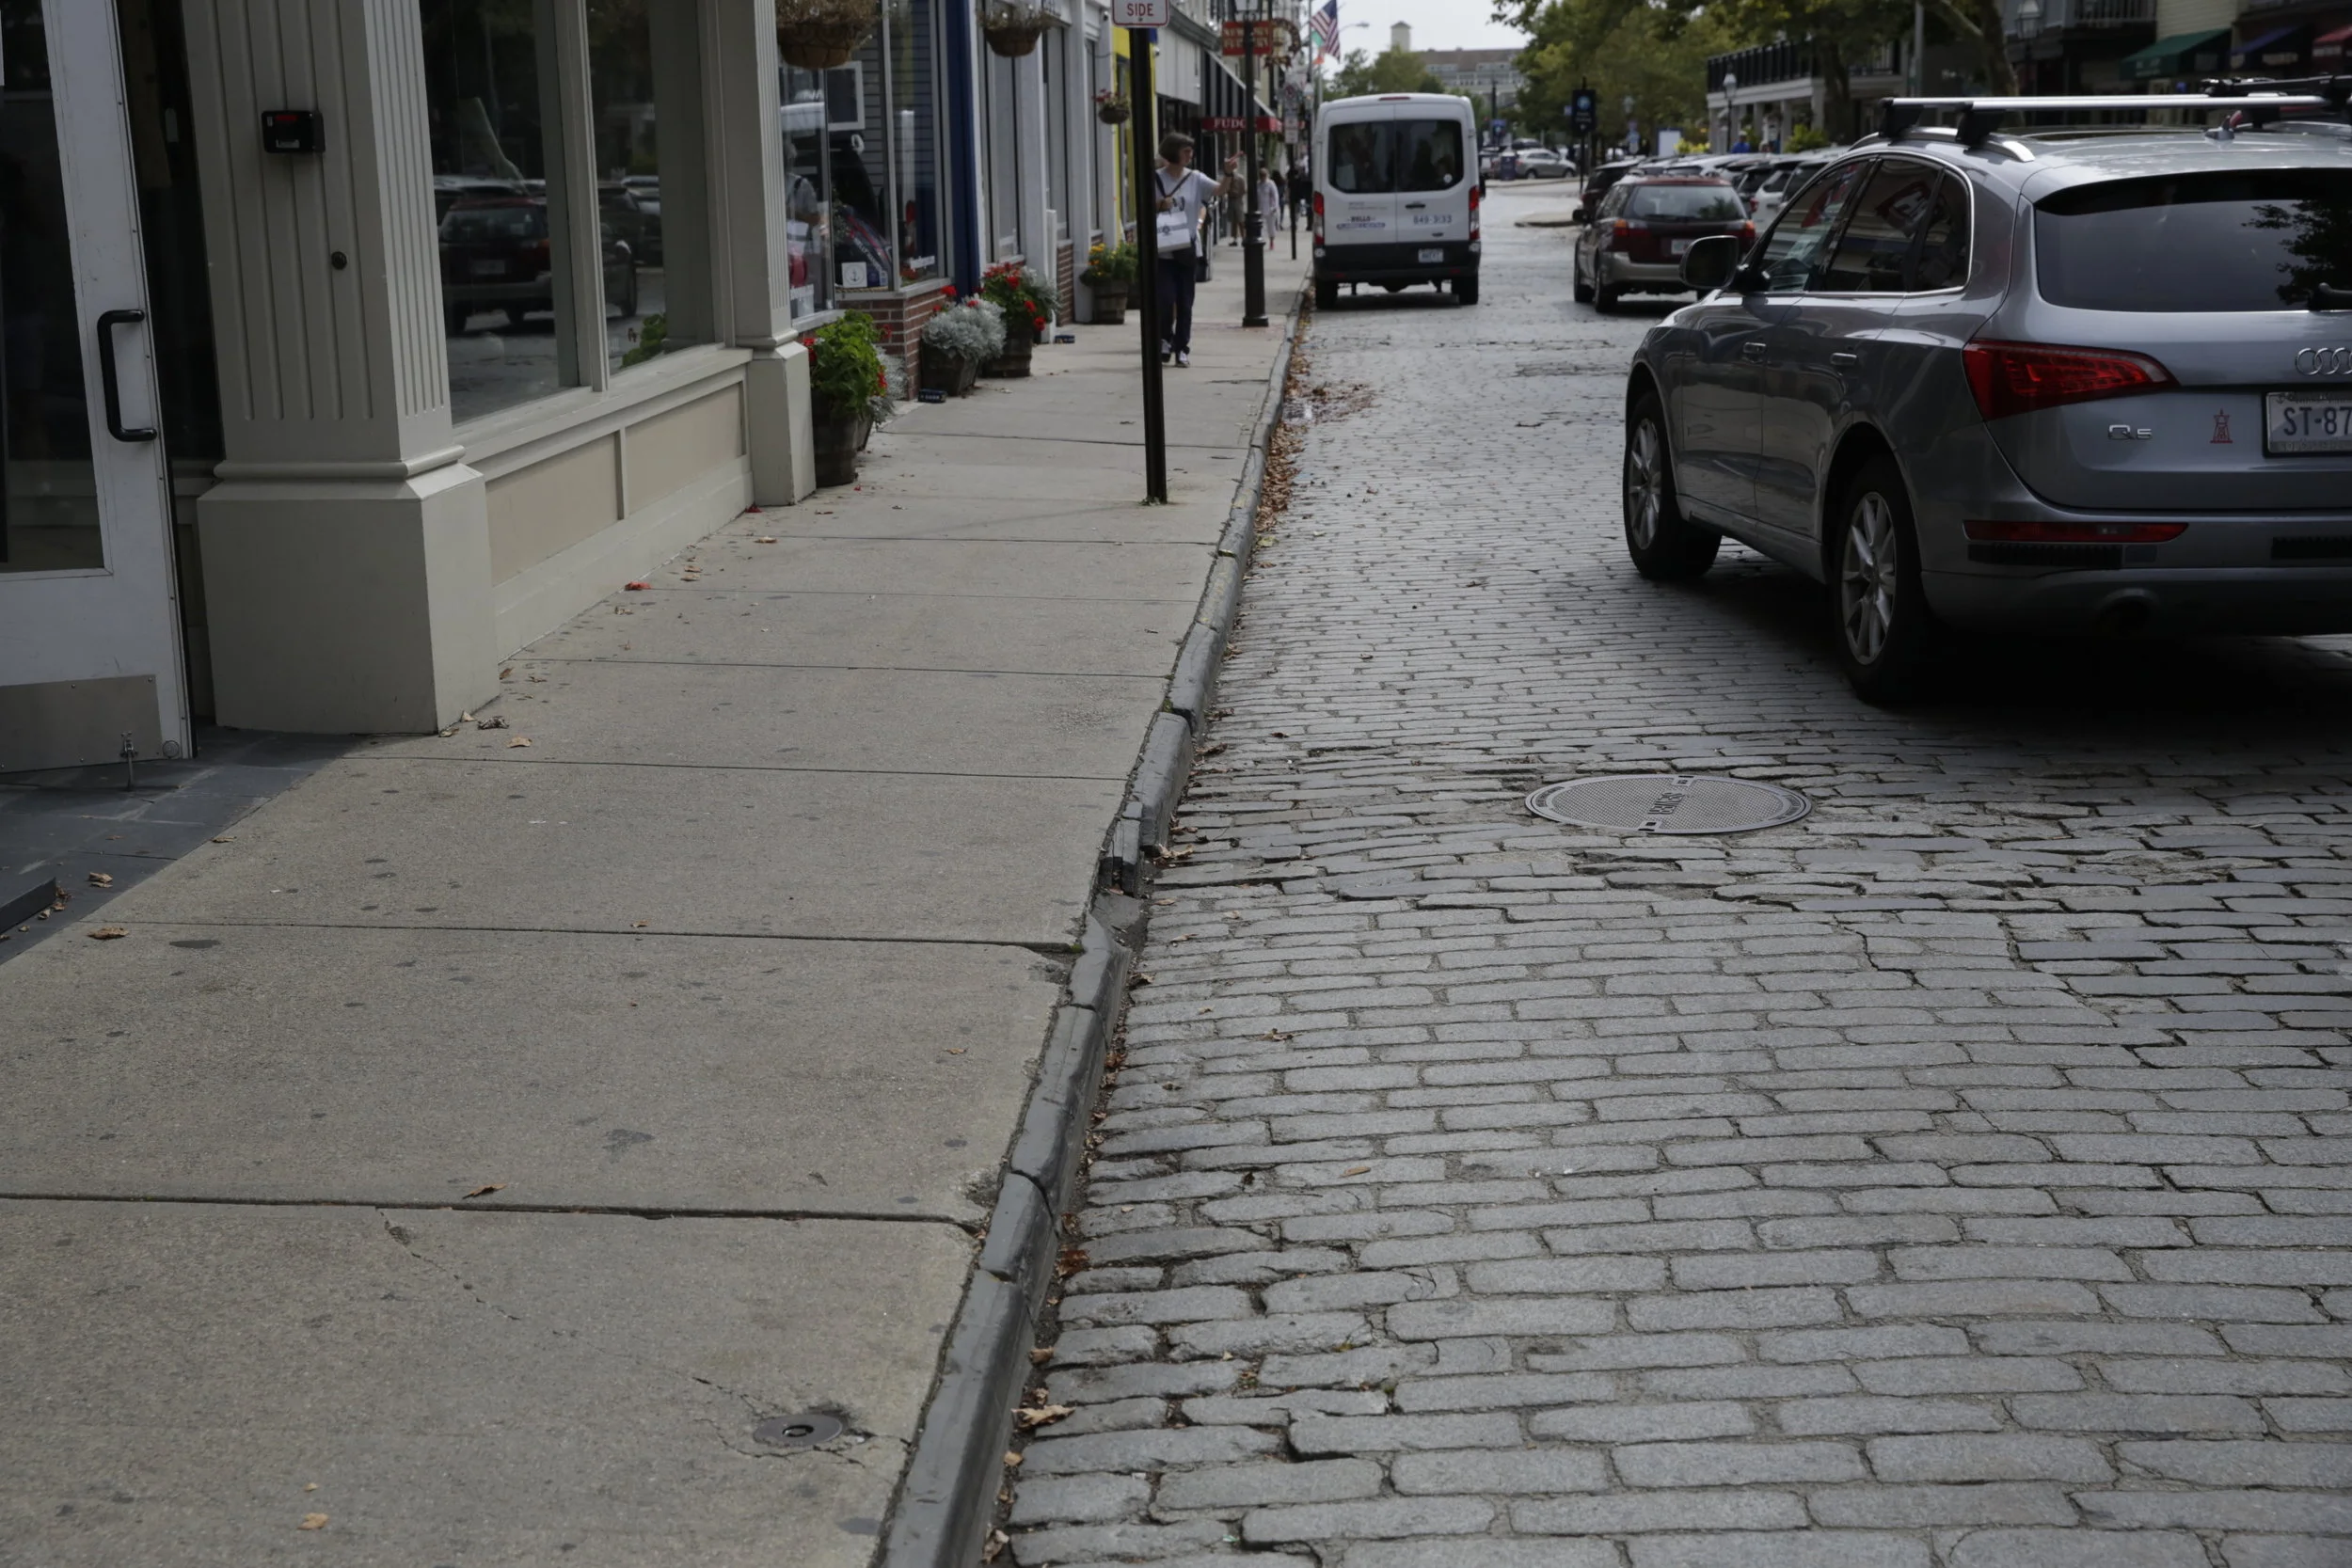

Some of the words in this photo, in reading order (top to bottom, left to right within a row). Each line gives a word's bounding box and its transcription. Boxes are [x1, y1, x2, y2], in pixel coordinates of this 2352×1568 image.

[1127, 3, 1154, 17] SIDE
[1214, 118, 1257, 129] FUDG
[2283, 406, 2352, 436] ST-87
[2107, 424, 2153, 440] Q5
